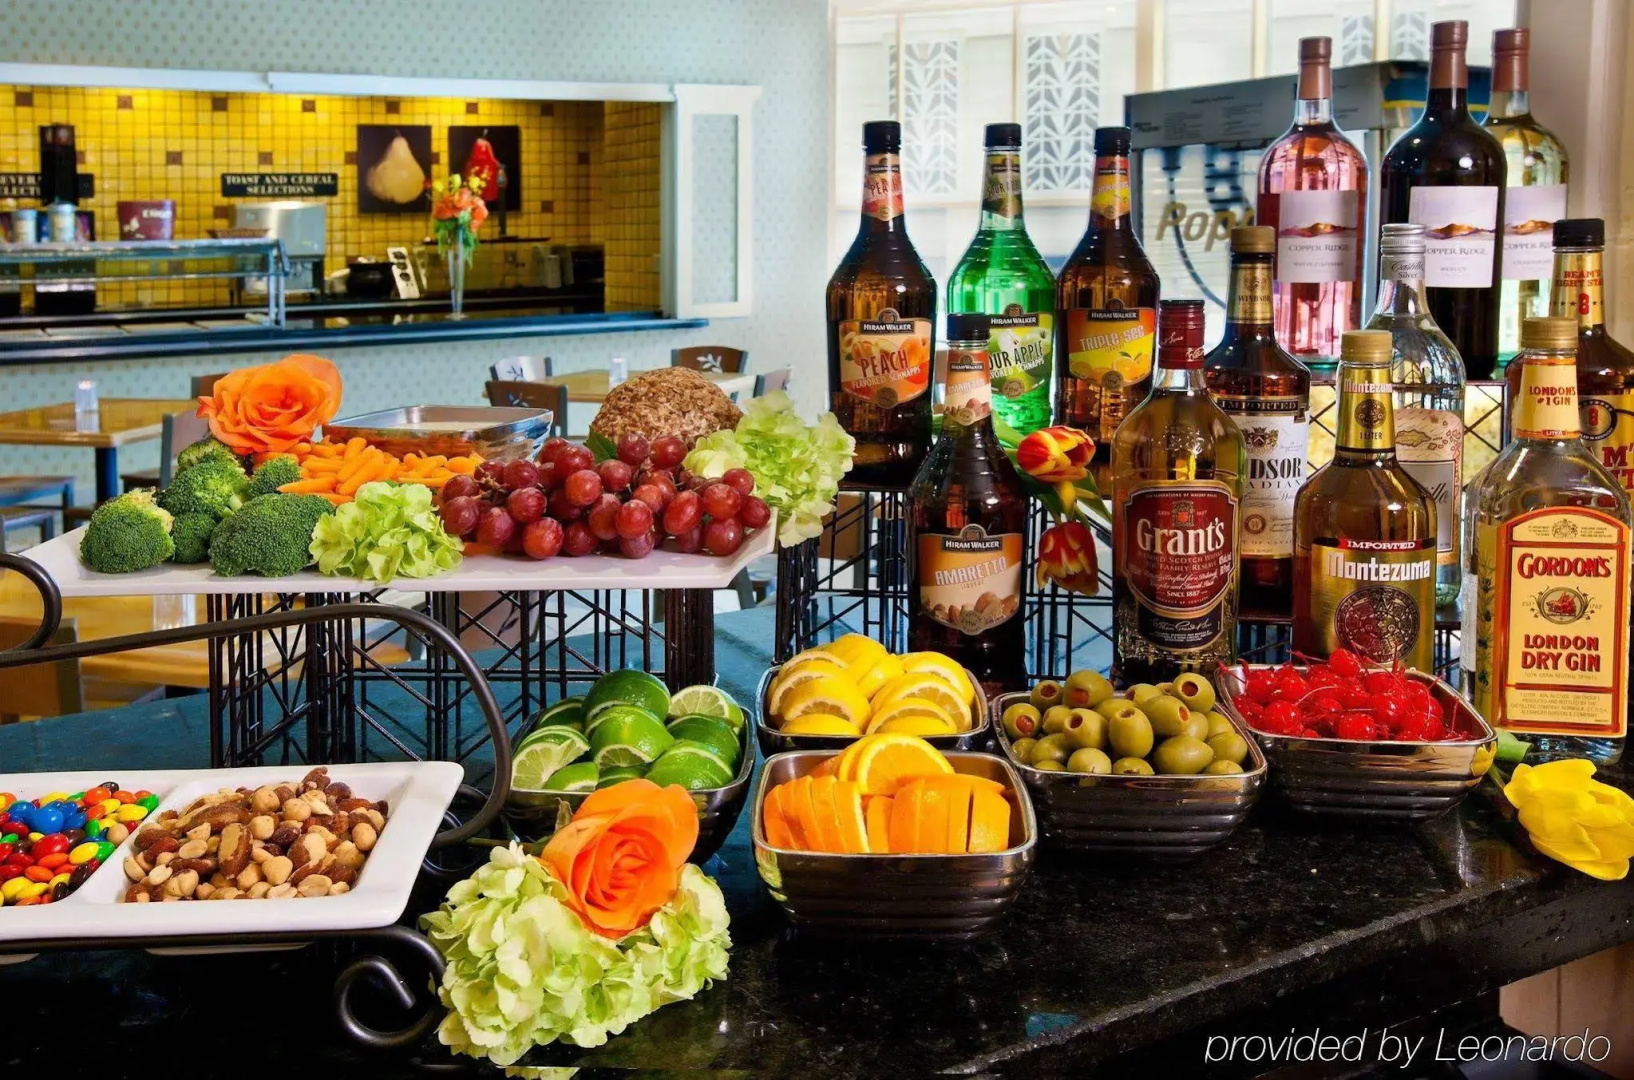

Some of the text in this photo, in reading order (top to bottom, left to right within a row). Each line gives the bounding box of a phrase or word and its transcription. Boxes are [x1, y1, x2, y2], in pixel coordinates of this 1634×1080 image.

[224, 175, 335, 185] TOAST AND CEREAL
[246, 185, 314, 194] SELECTIONS
[1288, 244, 1322, 252] COPPER
[1578, 293, 1589, 315] 8
[989, 340, 1043, 370] OUR APPLE
[860, 349, 908, 378] PEACH
[1017, 356, 1045, 372] SCHNAPPS
[852, 365, 921, 389] FLAVORED SCHNAPPS
[1344, 379, 1393, 393] Montezum
[1529, 386, 1576, 396] LONDON'S
[1220, 400, 1296, 409] IMPORTED
[1553, 396, 1571, 406] GIN
[1364, 432, 1383, 440] LITER
[1250, 457, 1301, 479] DSOR
[1246, 480, 1301, 489] ADIAN
[1137, 517, 1225, 556] Grant's
[945, 540, 1000, 549] HIRAM WALKER
[1347, 540, 1415, 550] IMPORTED
[1169, 555, 1203, 564] SCOTCH
[1327, 551, 1431, 581] Montezuma
[1517, 552, 1612, 579] GORDON'S
[935, 556, 1007, 586] AMARETTO
[1160, 563, 1189, 572] FAMILY
[1192, 562, 1217, 571] RESERVE
[1524, 634, 1600, 651] LONDON
[1521, 651, 1601, 672] DRY GIN
